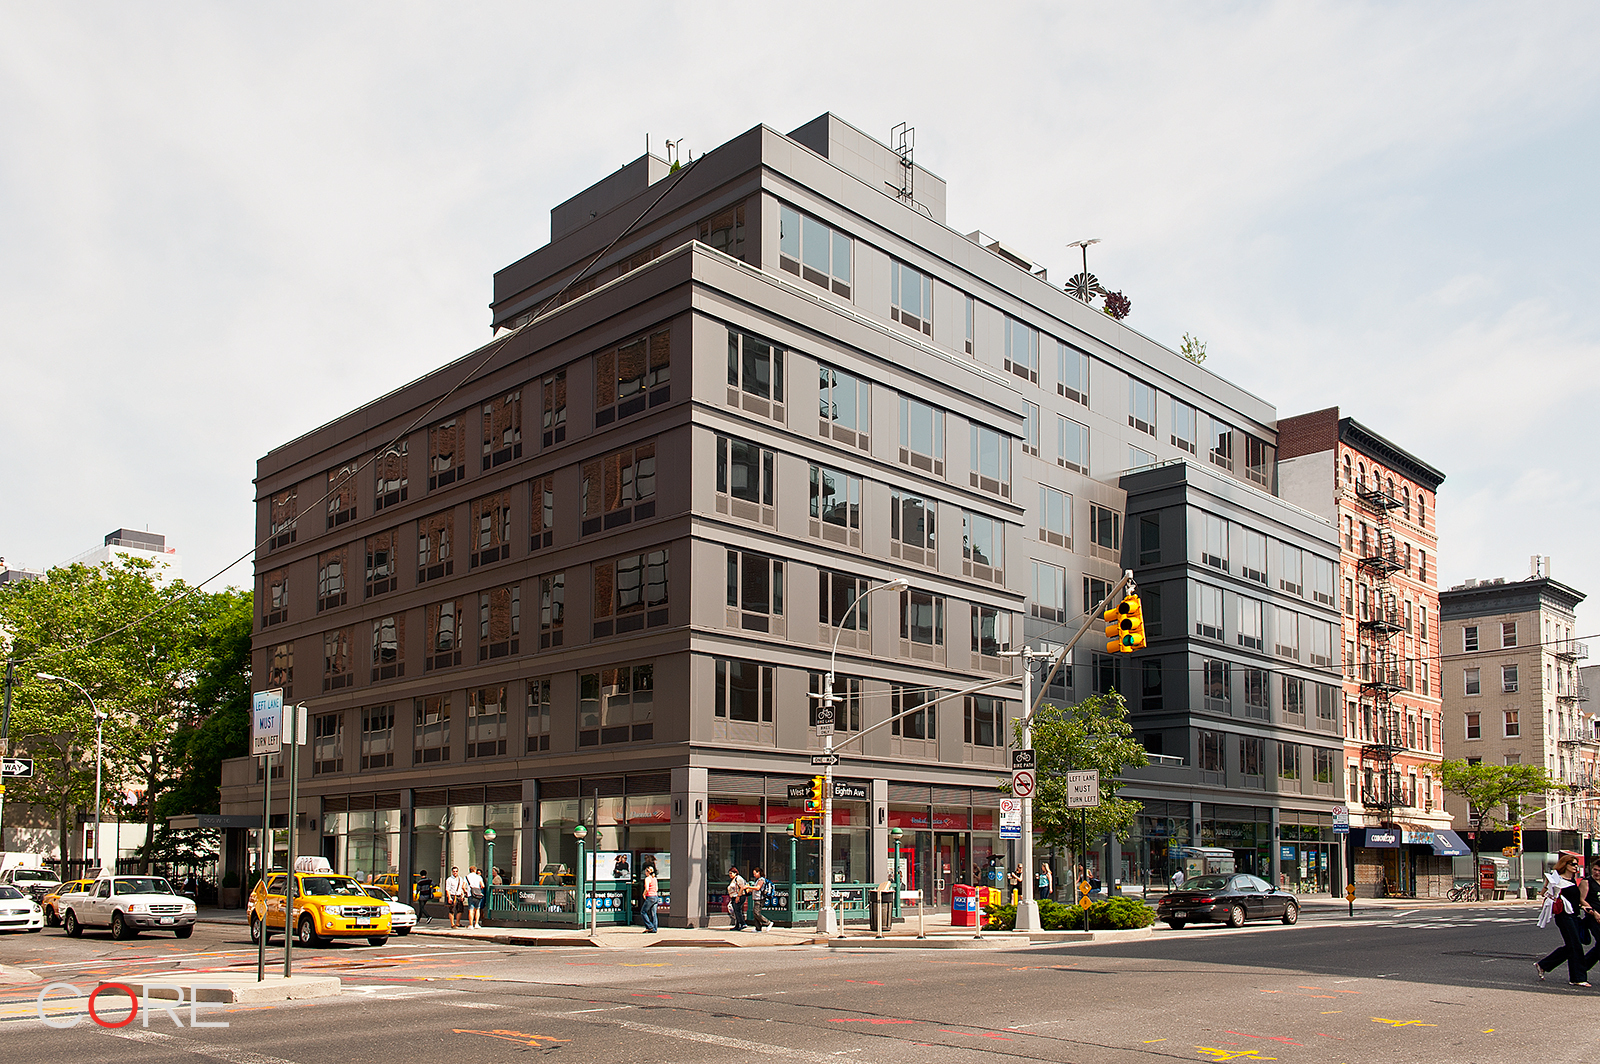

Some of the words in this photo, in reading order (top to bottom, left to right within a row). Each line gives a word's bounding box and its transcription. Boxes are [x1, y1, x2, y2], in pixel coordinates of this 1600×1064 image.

[256, 700, 266, 712] LEFT
[268, 698, 279, 710] LANE
[260, 716, 275, 730] MUST
[255, 736, 266, 748] TURN
[268, 734, 278, 746] LEFT
[835, 787, 853, 798] Eighth
[853, 788, 865, 797] Ave
[519, 892, 536, 900] Subway
